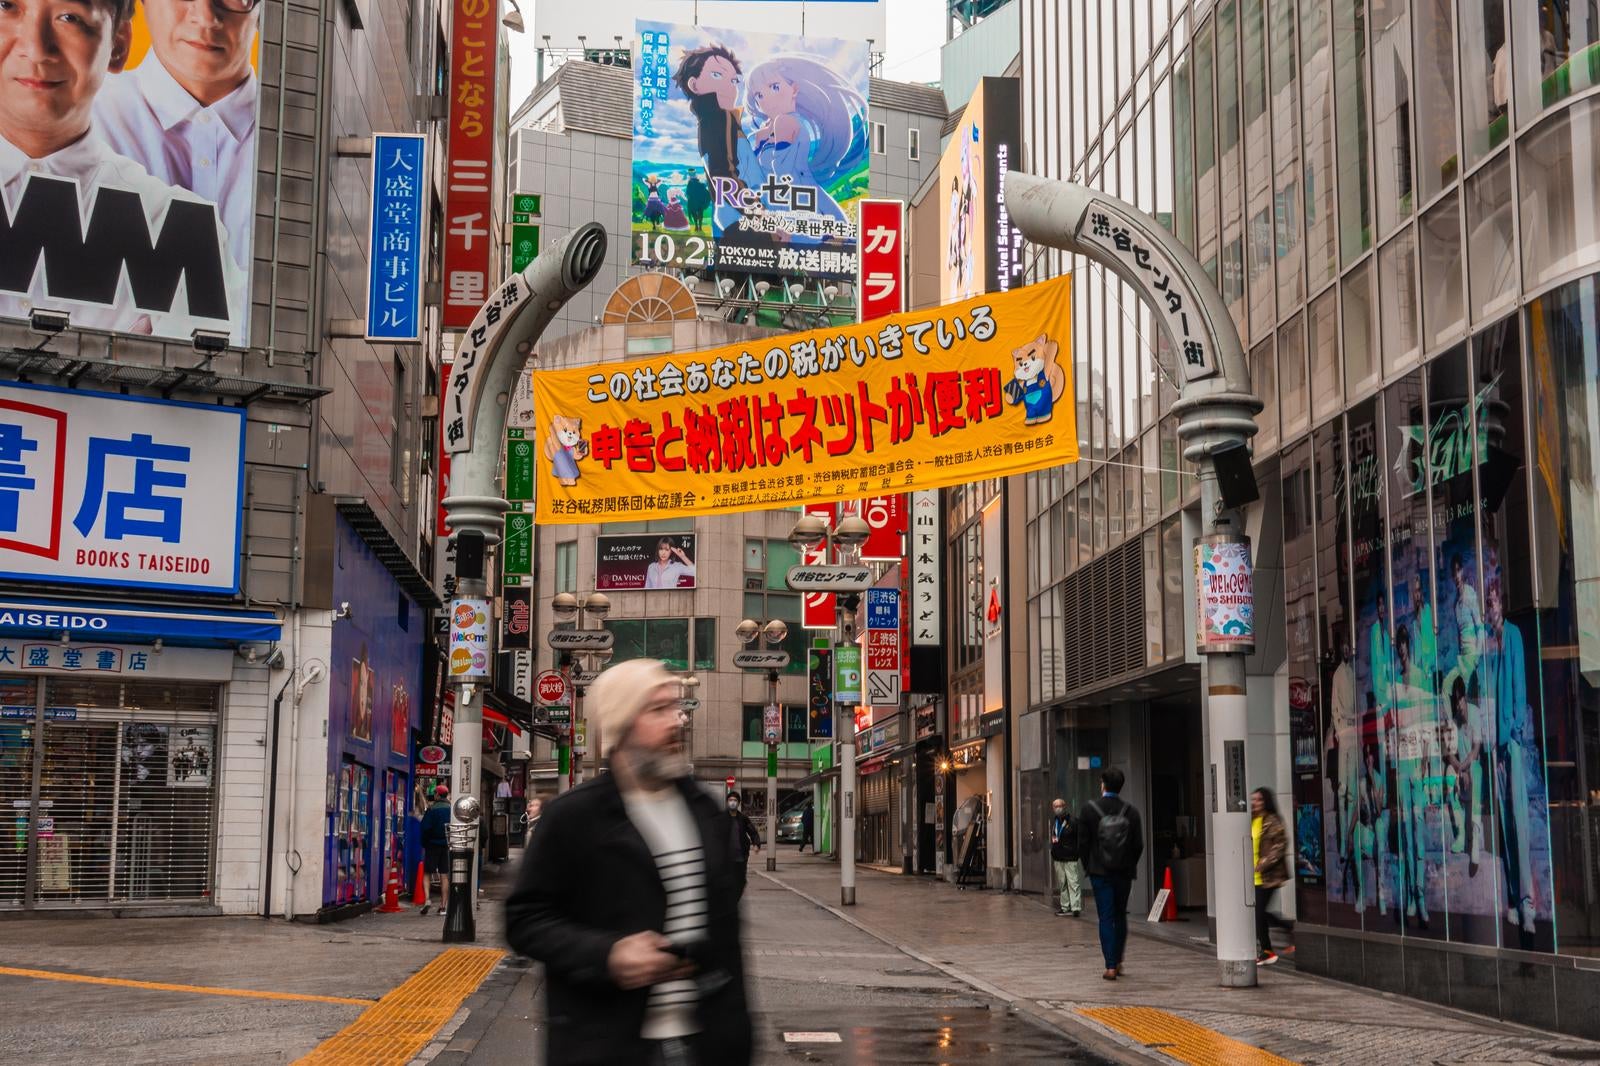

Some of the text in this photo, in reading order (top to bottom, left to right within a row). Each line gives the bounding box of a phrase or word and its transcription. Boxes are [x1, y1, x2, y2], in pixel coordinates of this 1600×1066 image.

[997, 144, 1008, 204] Psents
[380, 148, 414, 328] 大盛堂商事ビル
[447, 159, 489, 306] 三千里
[639, 232, 706, 265] 10.2
[719, 246, 756, 258] TOKYO
[778, 248, 857, 274] 放送開始
[1091, 211, 1205, 368] 渋谷センター街
[447, 282, 519, 447] 渋谷センター街
[587, 306, 997, 402] この社会あなたの税がいきている
[591, 367, 1004, 474] 申告と納税はネットが便利
[1457, 497, 1488, 517] Relese
[76, 548, 211, 575] BOOKS TAISEIDO
[916, 514, 935, 640] 山下本気うどん
[869, 617, 898, 626] クリニック
[875, 606, 891, 615] 眼科
[452, 631, 488, 643] Welcome
[880, 633, 897, 646] 渋谷
[0, 646, 148, 672] 大盛堂書店
[868, 648, 898, 657] コンタクト
[875, 658, 892, 667] レンズ
[540, 681, 563, 694] 消火栓
